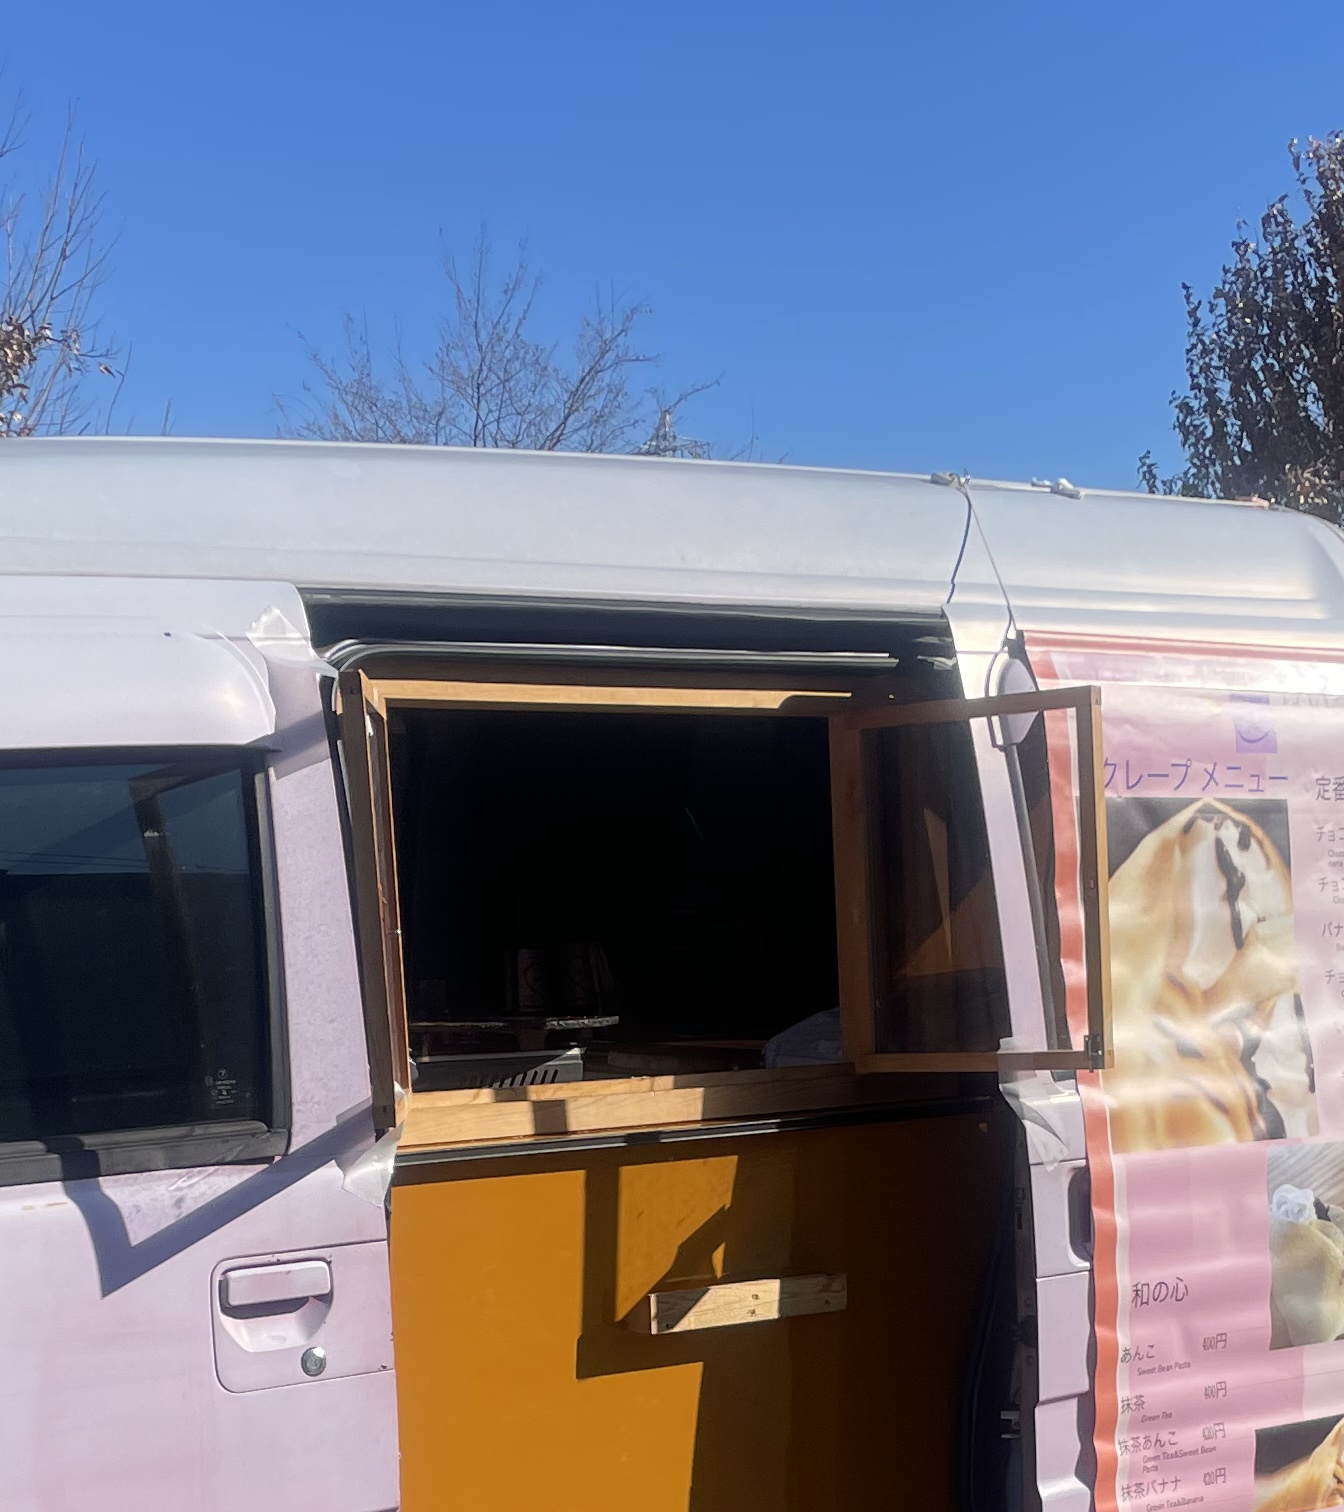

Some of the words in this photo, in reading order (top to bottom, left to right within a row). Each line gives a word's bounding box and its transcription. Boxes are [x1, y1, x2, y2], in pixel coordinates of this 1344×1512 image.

[1131, 1276, 1189, 1308] 和の心
[1120, 1344, 1155, 1363] あんこ
[1120, 1394, 1146, 1415] 抹茶
[1118, 1430, 1178, 1457] 抹茶あんこ
[1121, 1475, 1182, 1502] 抹茶バナナ
